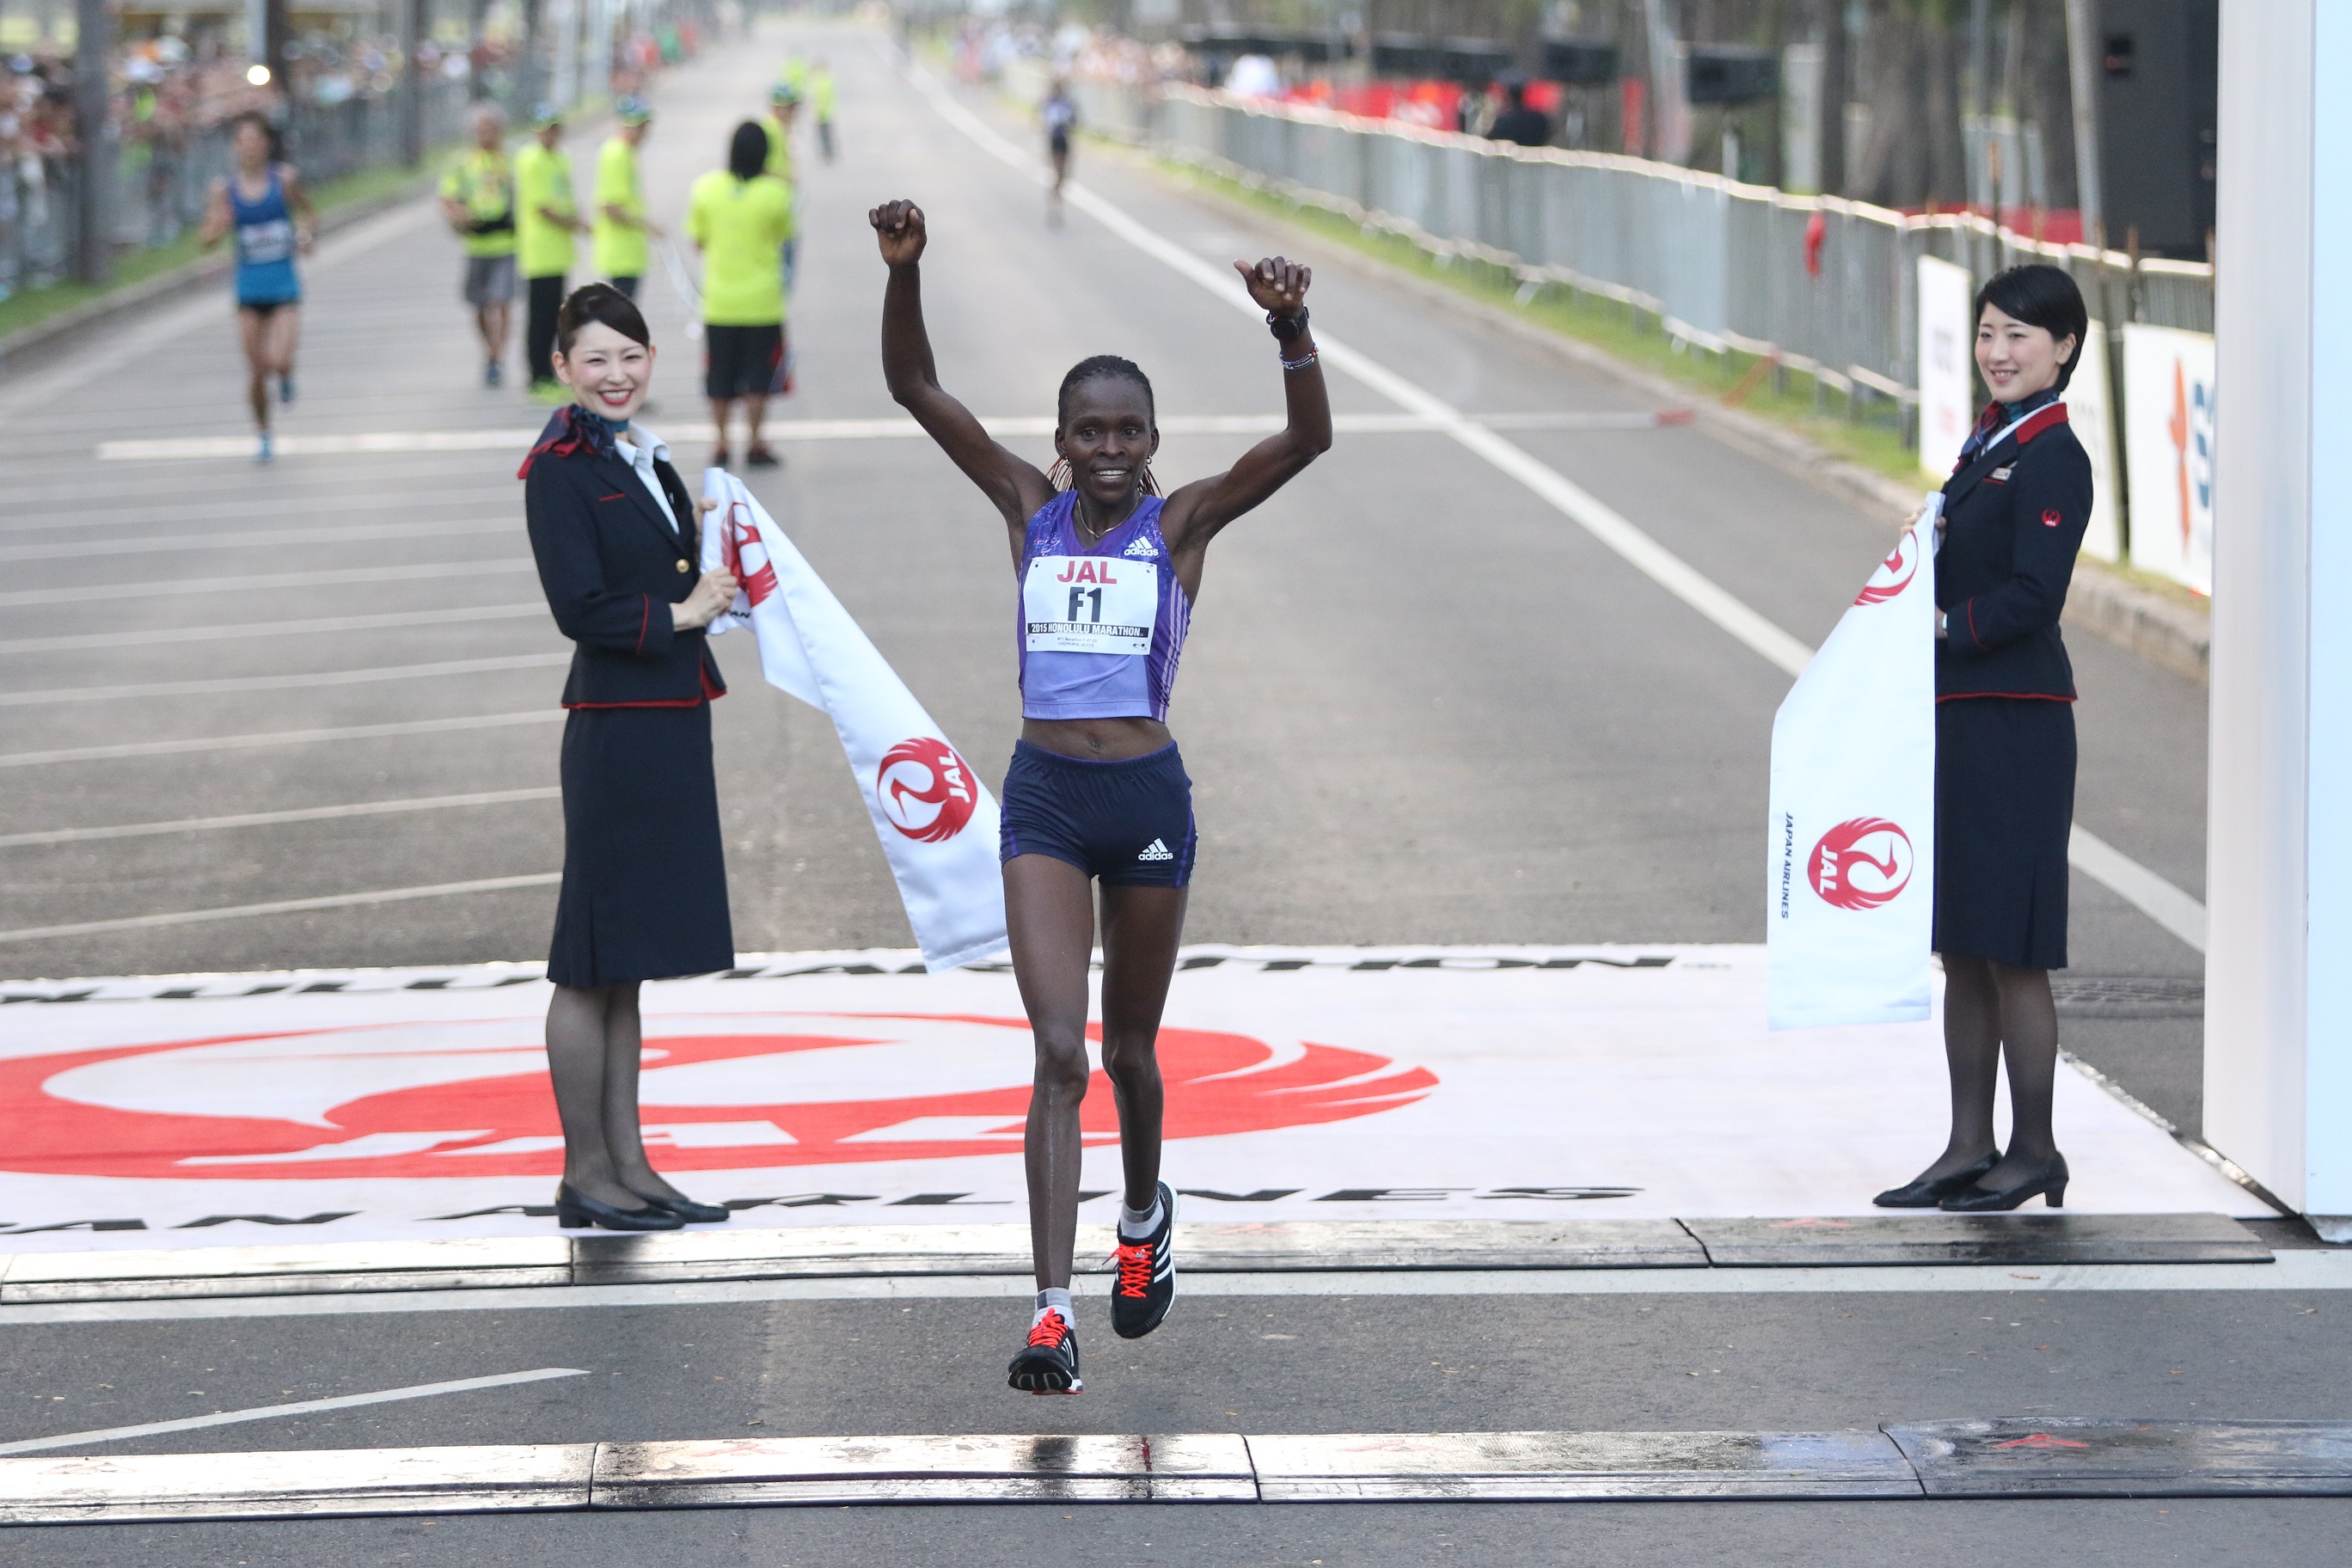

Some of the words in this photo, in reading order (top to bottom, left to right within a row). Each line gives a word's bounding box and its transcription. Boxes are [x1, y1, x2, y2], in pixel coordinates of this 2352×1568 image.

[1124, 547, 1159, 555] adidas
[1057, 560, 1117, 585] JAL
[1068, 586, 1102, 622] F1
[1032, 623, 1048, 633] 2015
[1048, 623, 1090, 634] HONOLULU
[1092, 625, 1141, 636] MARATHON
[939, 750, 971, 804] JAL
[1138, 851, 1173, 861] adidas
[1819, 844, 1839, 895] JAL
[1781, 860, 1792, 919] AIRLINES
